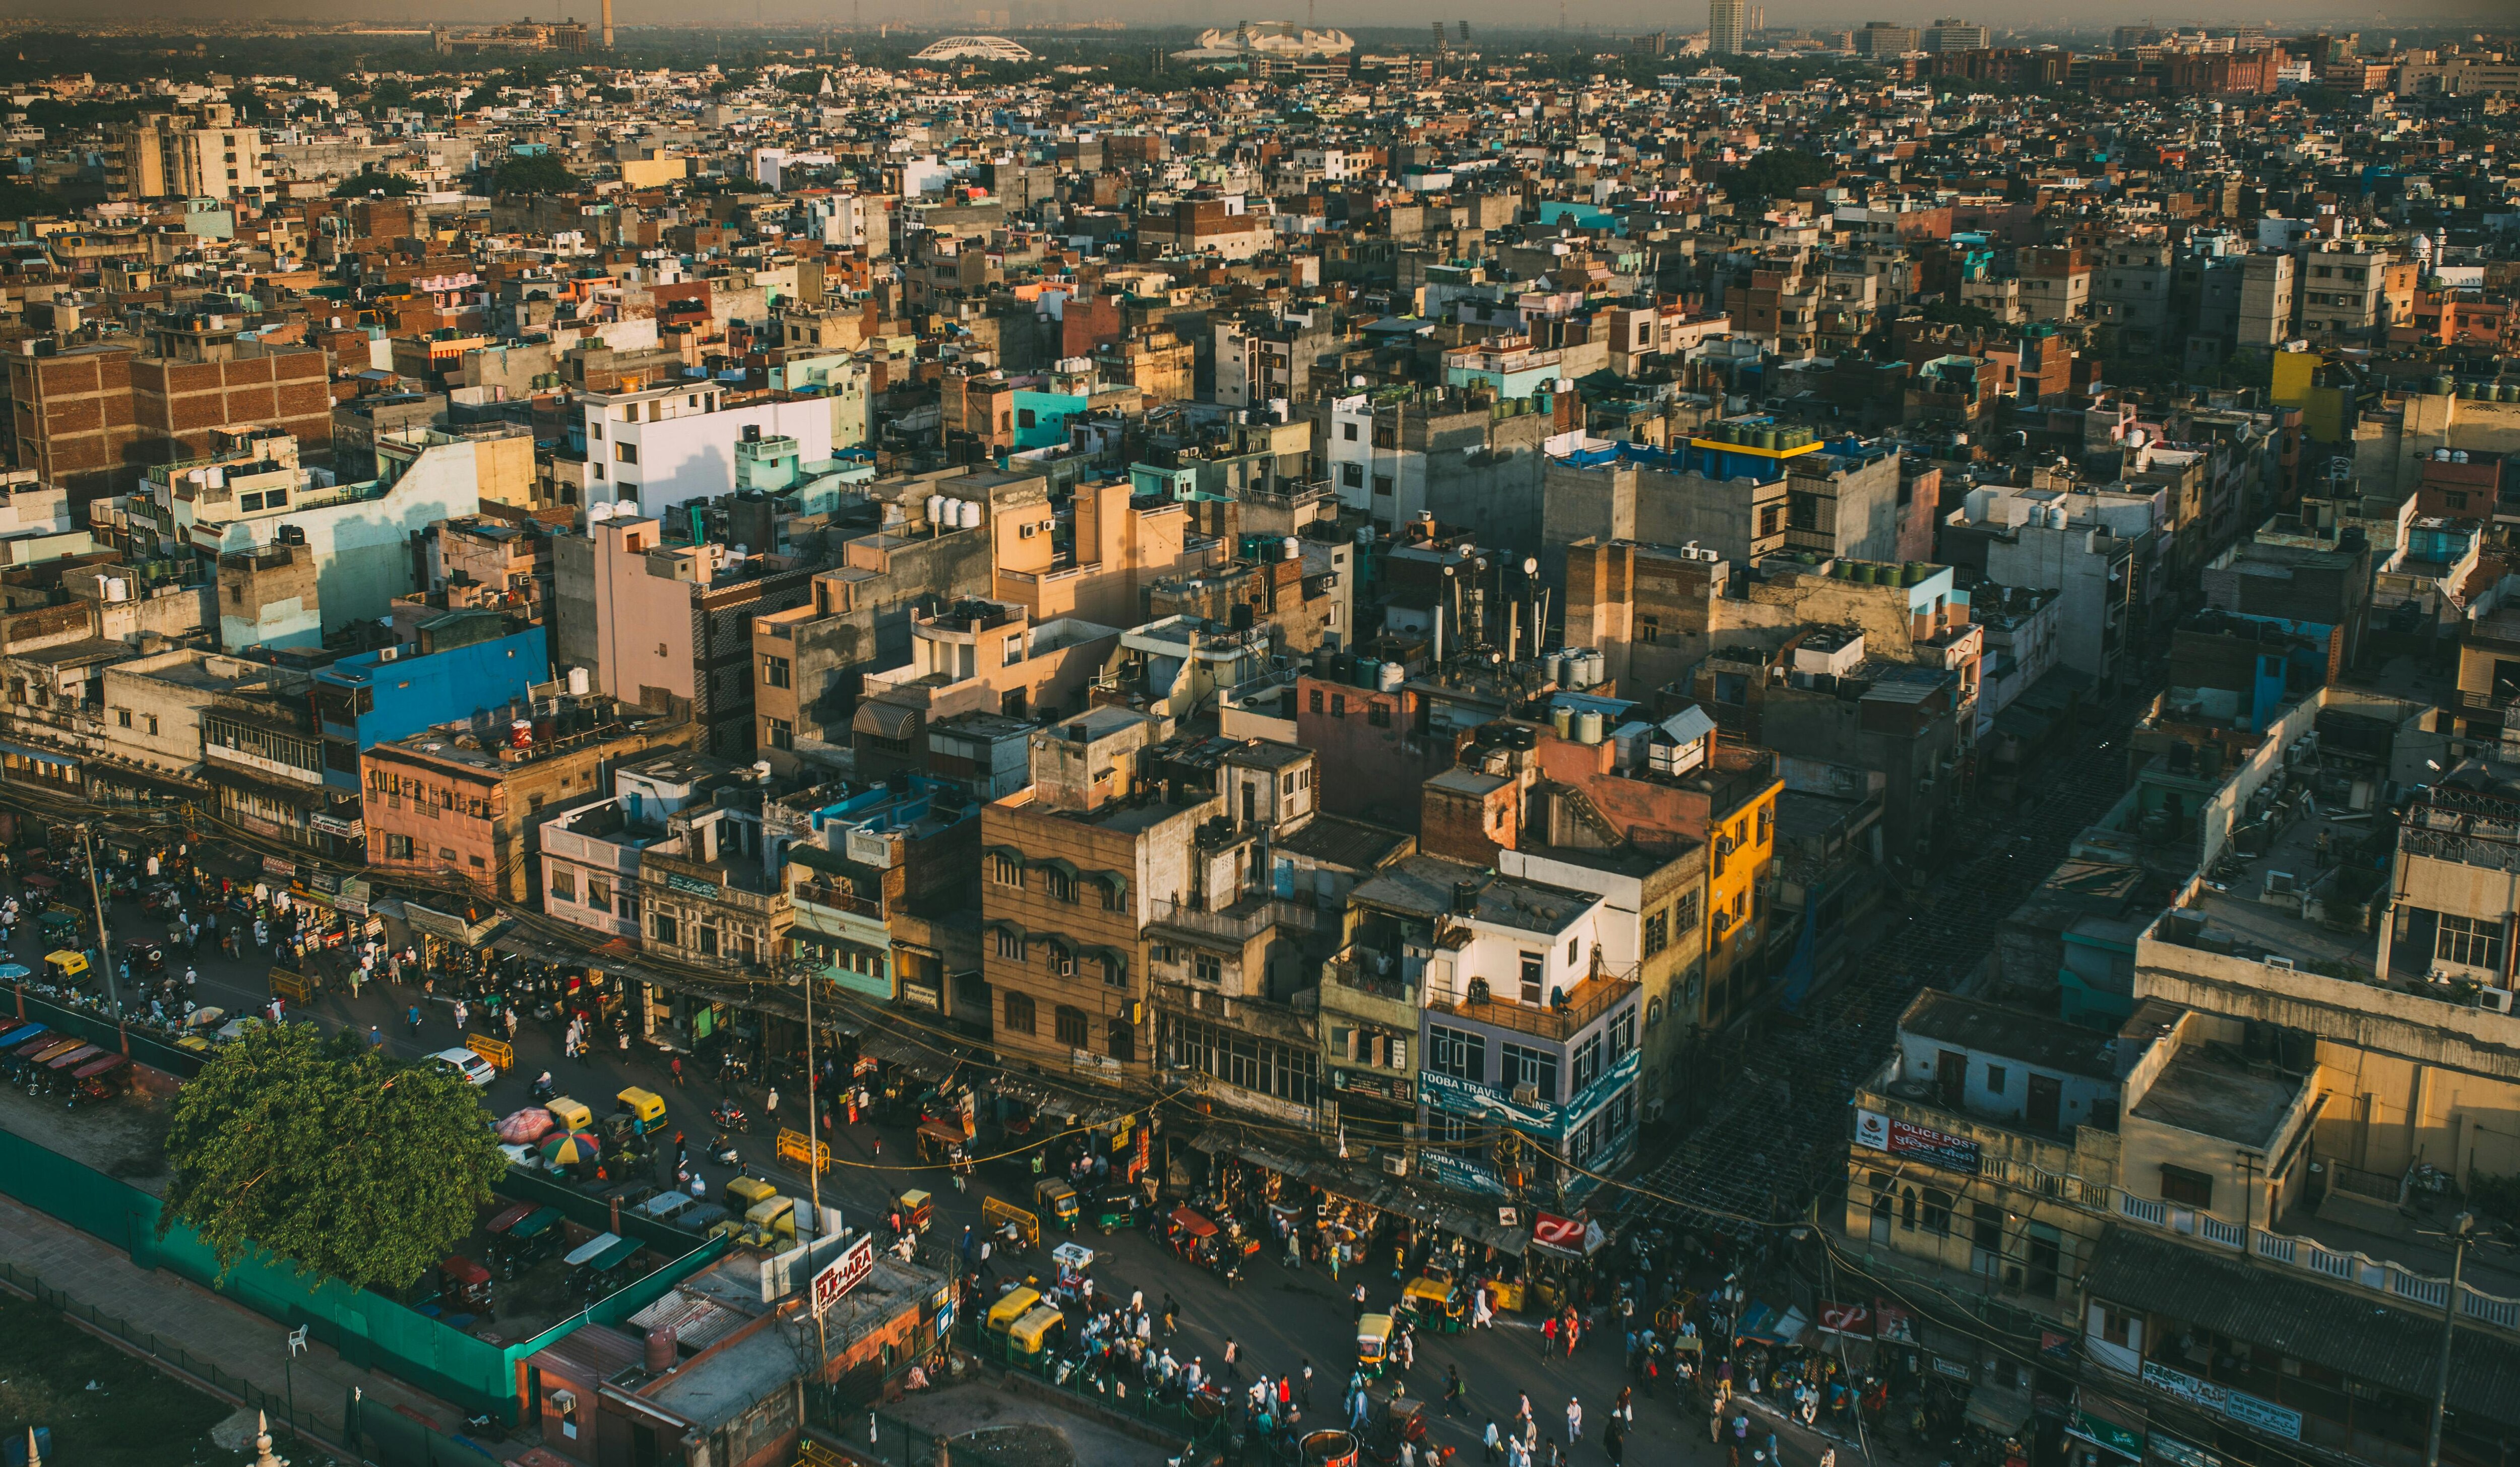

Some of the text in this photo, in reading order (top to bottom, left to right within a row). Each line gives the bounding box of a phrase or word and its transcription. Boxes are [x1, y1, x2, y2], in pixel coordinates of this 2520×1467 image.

[1421, 1071, 1459, 1089] TOOBA
[1462, 1081, 1505, 1101] TRAVEL
[1508, 1095, 1551, 1113] INE
[1894, 1120, 1978, 1151] POLICE POST
[1895, 1134, 1936, 1152] पुलिस
[1939, 1145, 1975, 1163] चौकी
[1420, 1149, 1456, 1167] TOOBA
[815, 1267, 836, 1289] HOTEL
[816, 1249, 871, 1305] BUKHARA
[2113, 1435, 2134, 1444] Sprite
